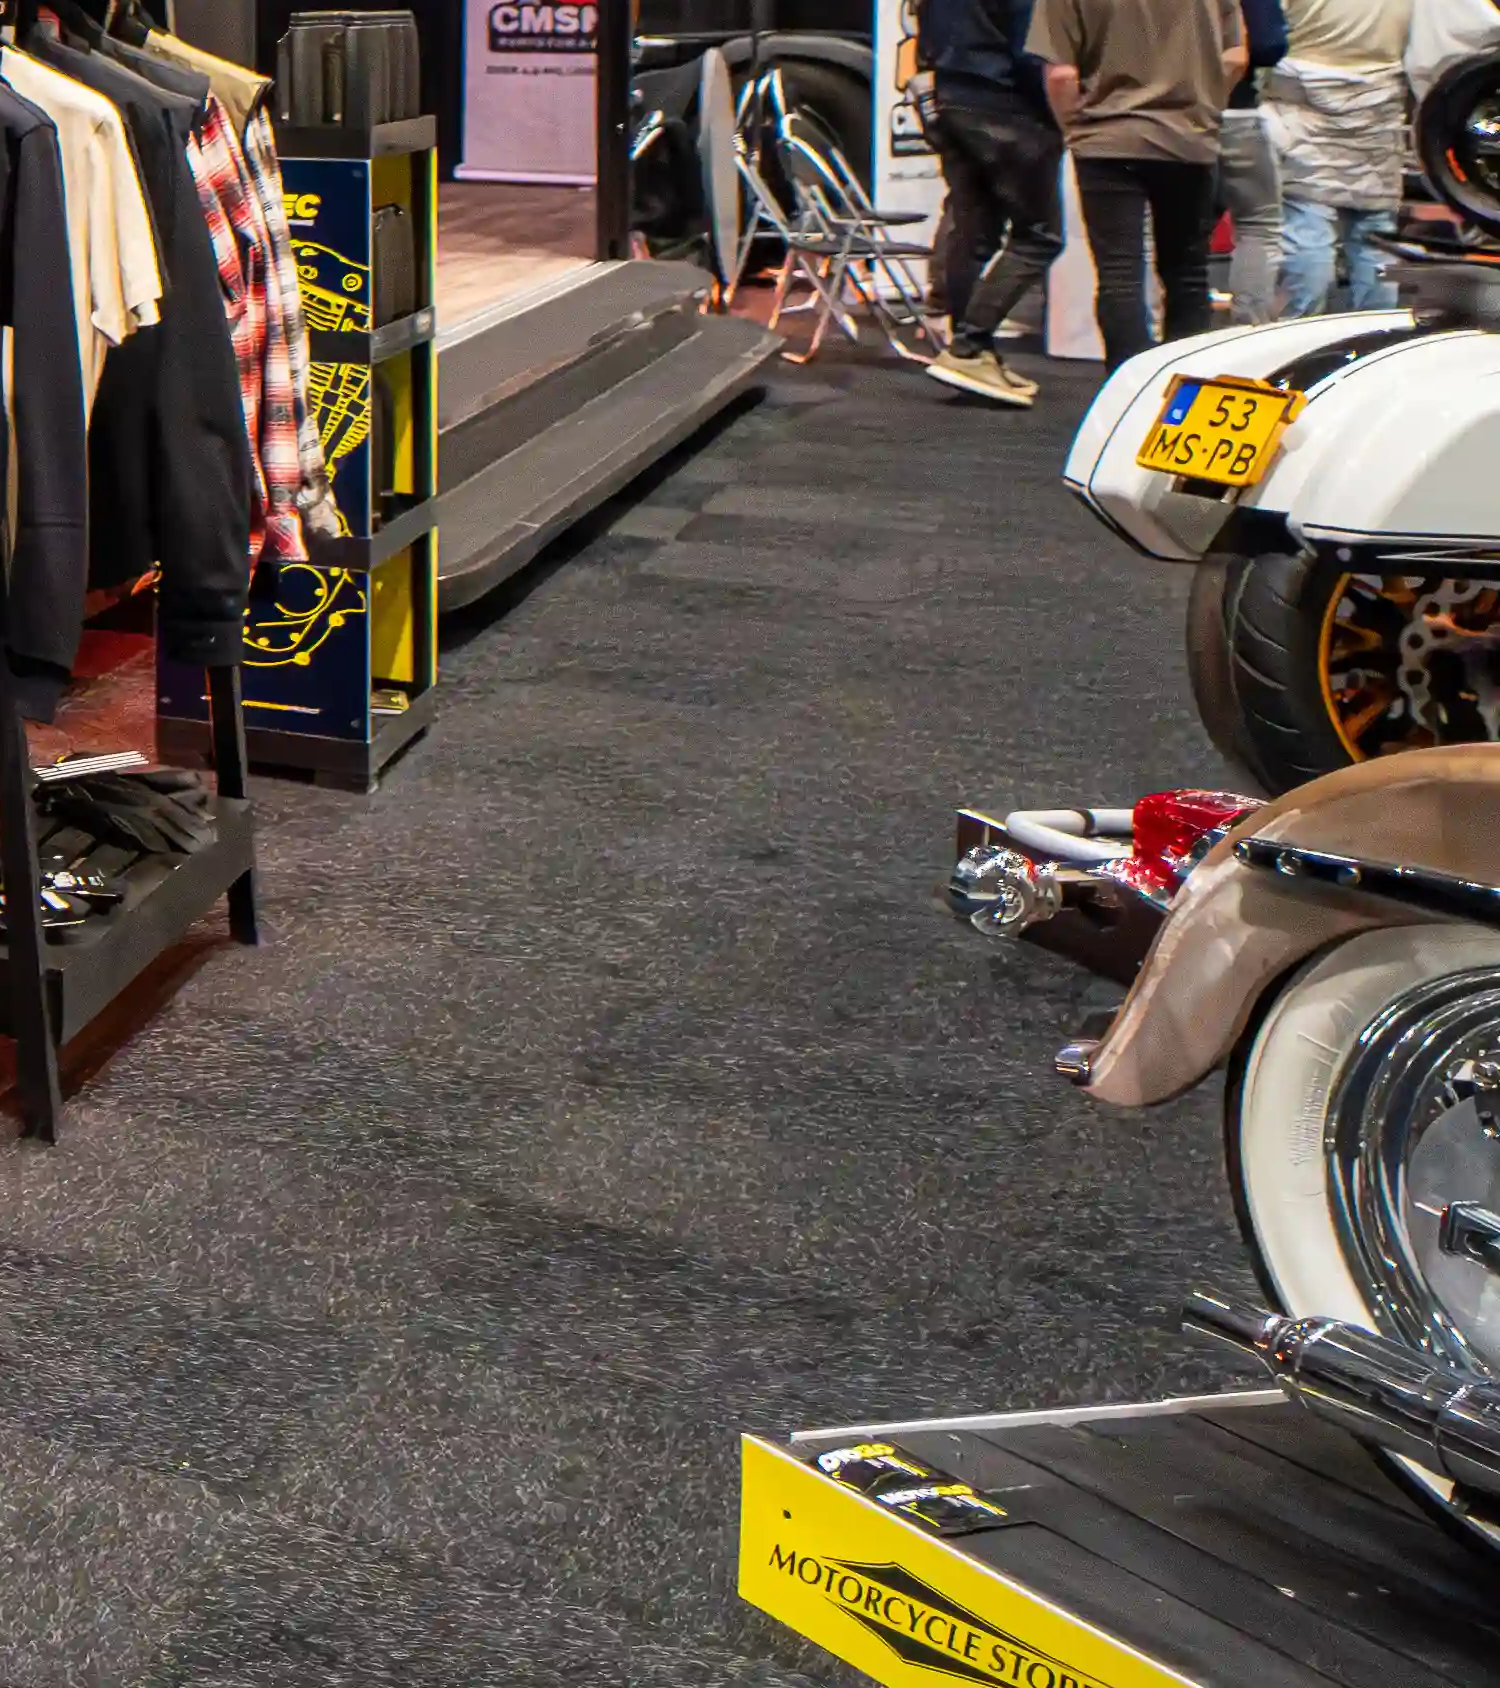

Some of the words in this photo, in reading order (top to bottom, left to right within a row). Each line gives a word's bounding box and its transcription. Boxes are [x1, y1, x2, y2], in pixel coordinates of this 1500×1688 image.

[1208, 394, 1258, 431] 53
[768, 1543, 982, 1662] MOTORCYCLE
[987, 1644, 1091, 1688] STOR
